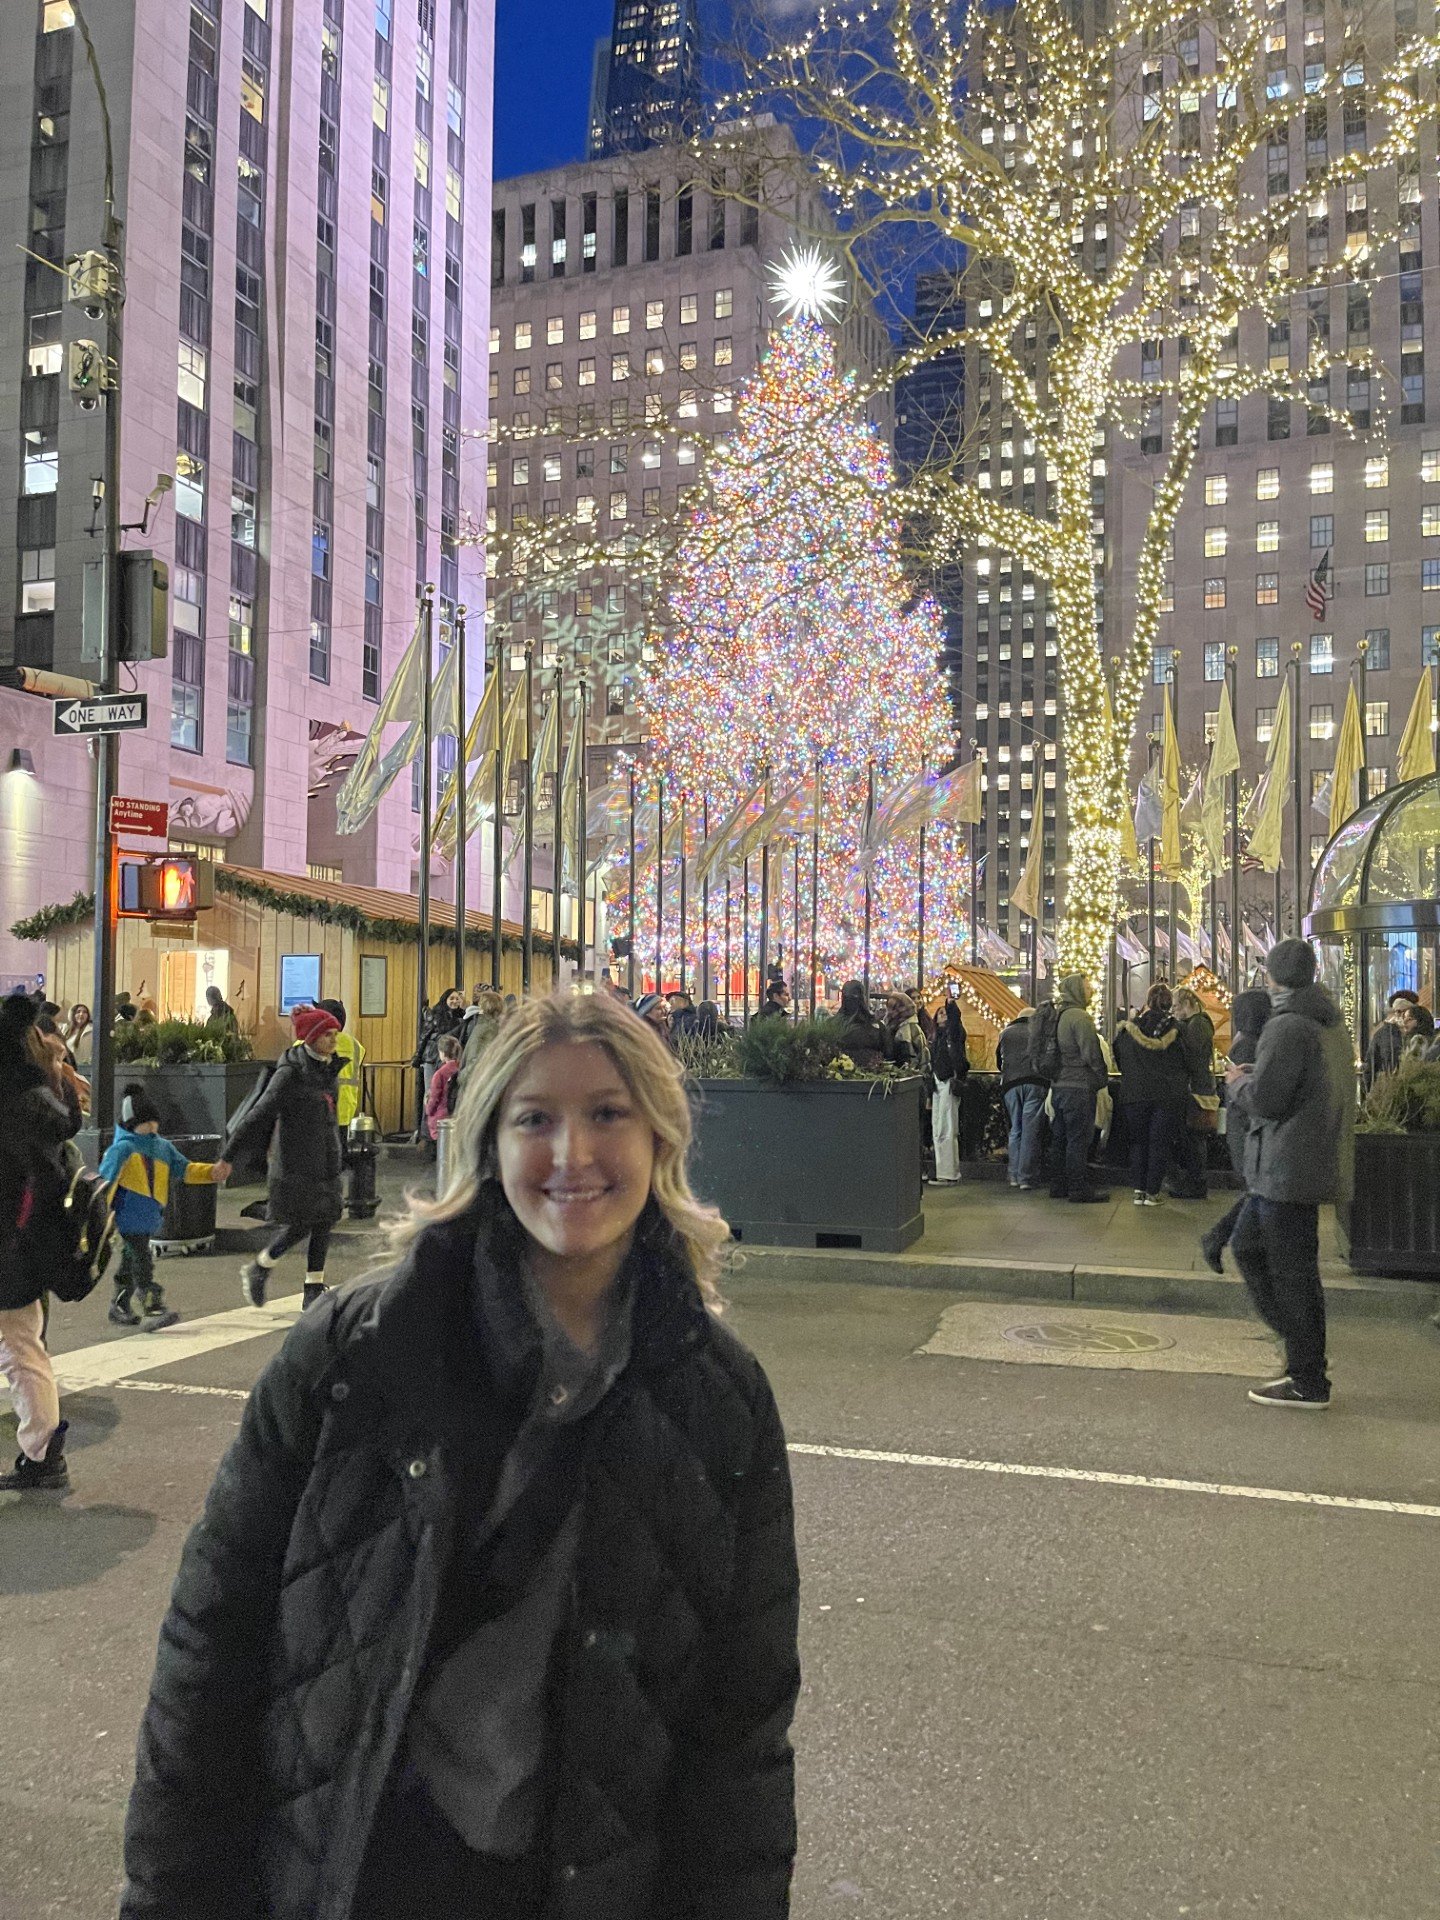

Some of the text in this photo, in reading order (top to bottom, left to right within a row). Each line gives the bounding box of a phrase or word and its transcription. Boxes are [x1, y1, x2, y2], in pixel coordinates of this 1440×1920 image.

[69, 705, 136, 723] ONE WAY
[114, 800, 161, 812] NO STANDING
[114, 808, 144, 819] Anytime
